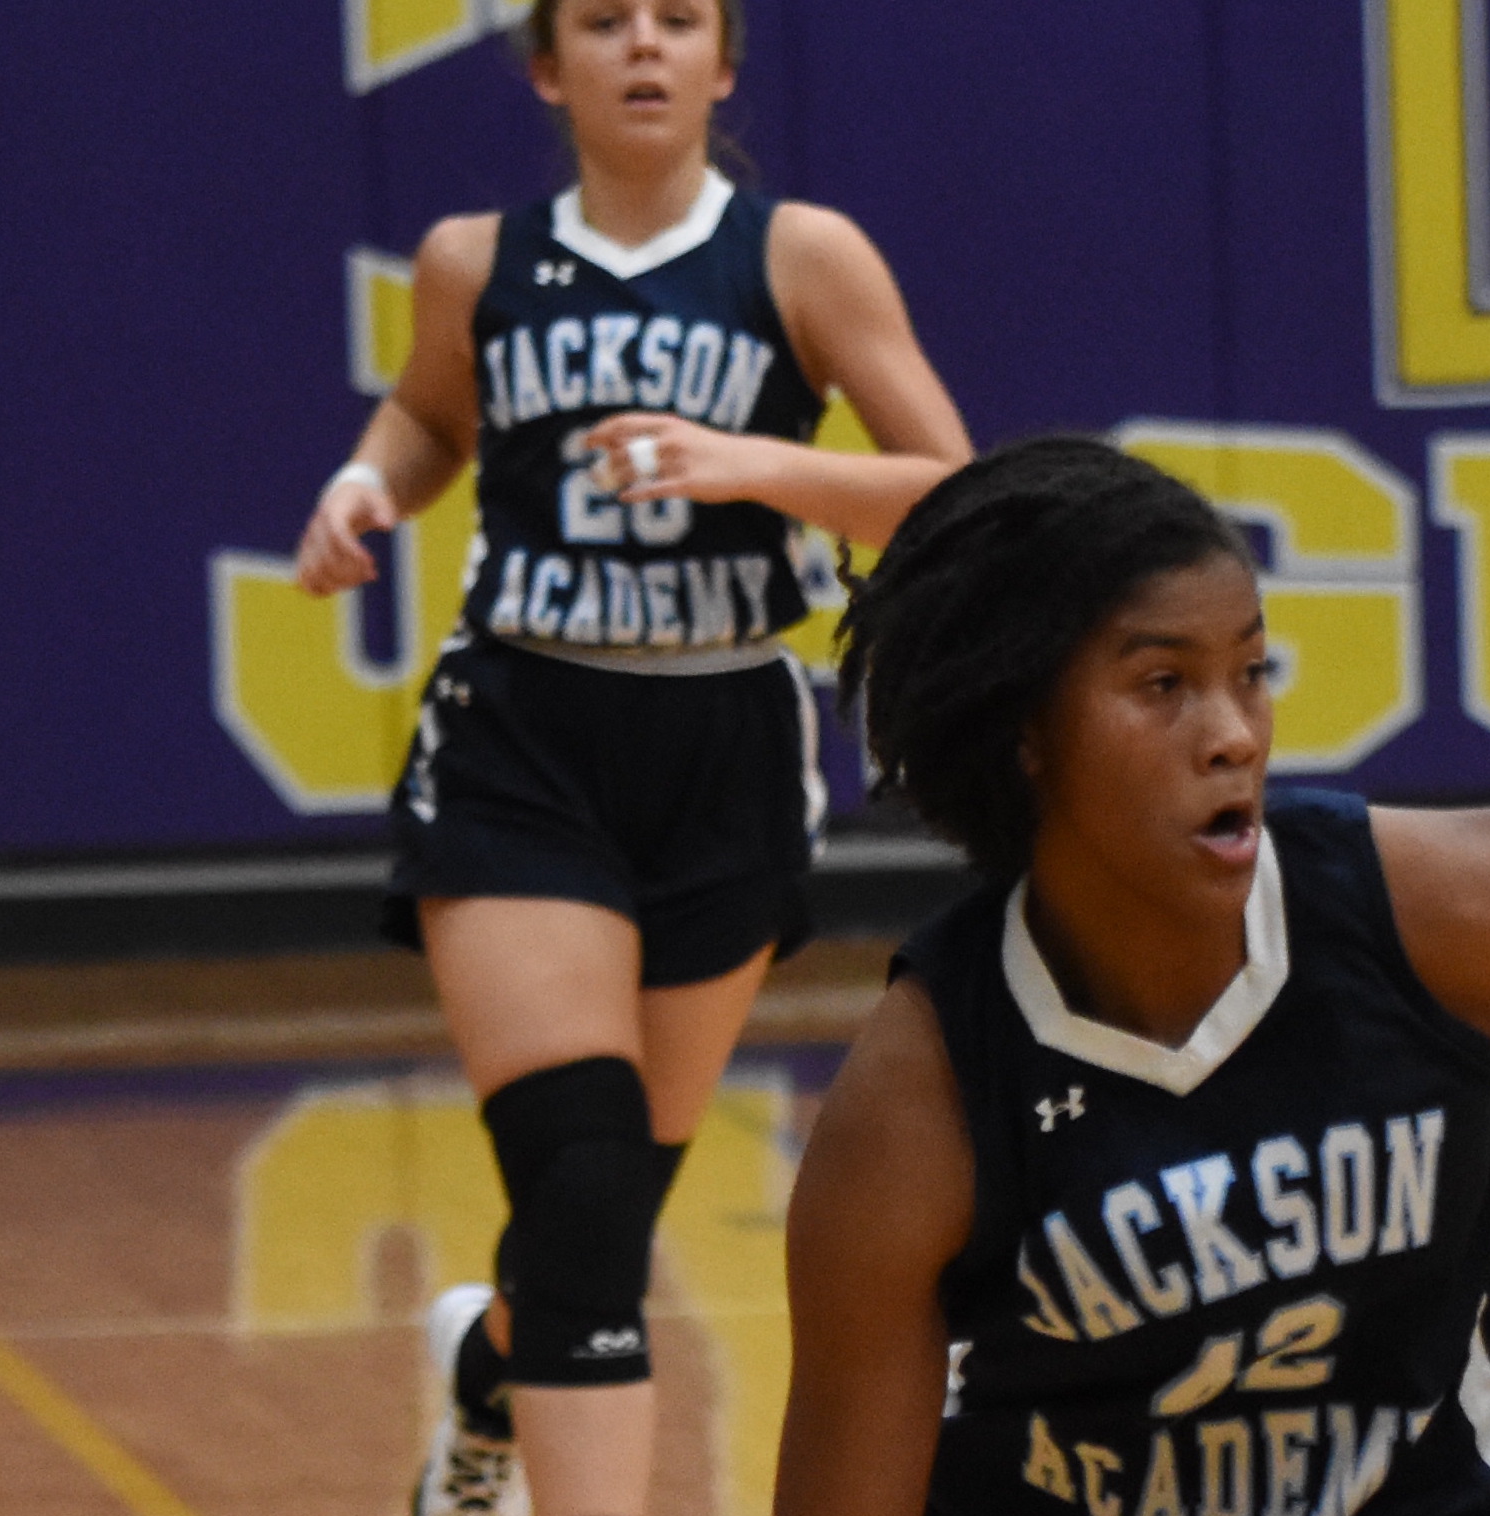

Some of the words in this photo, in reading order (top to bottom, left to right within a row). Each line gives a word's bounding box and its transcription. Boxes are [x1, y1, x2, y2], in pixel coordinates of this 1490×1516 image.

[484, 310, 775, 433] JACKSON
[486, 546, 772, 647] ACADEMY
[1016, 1108, 1446, 1343] JACKSON
[1150, 1294, 1347, 1419] 12
